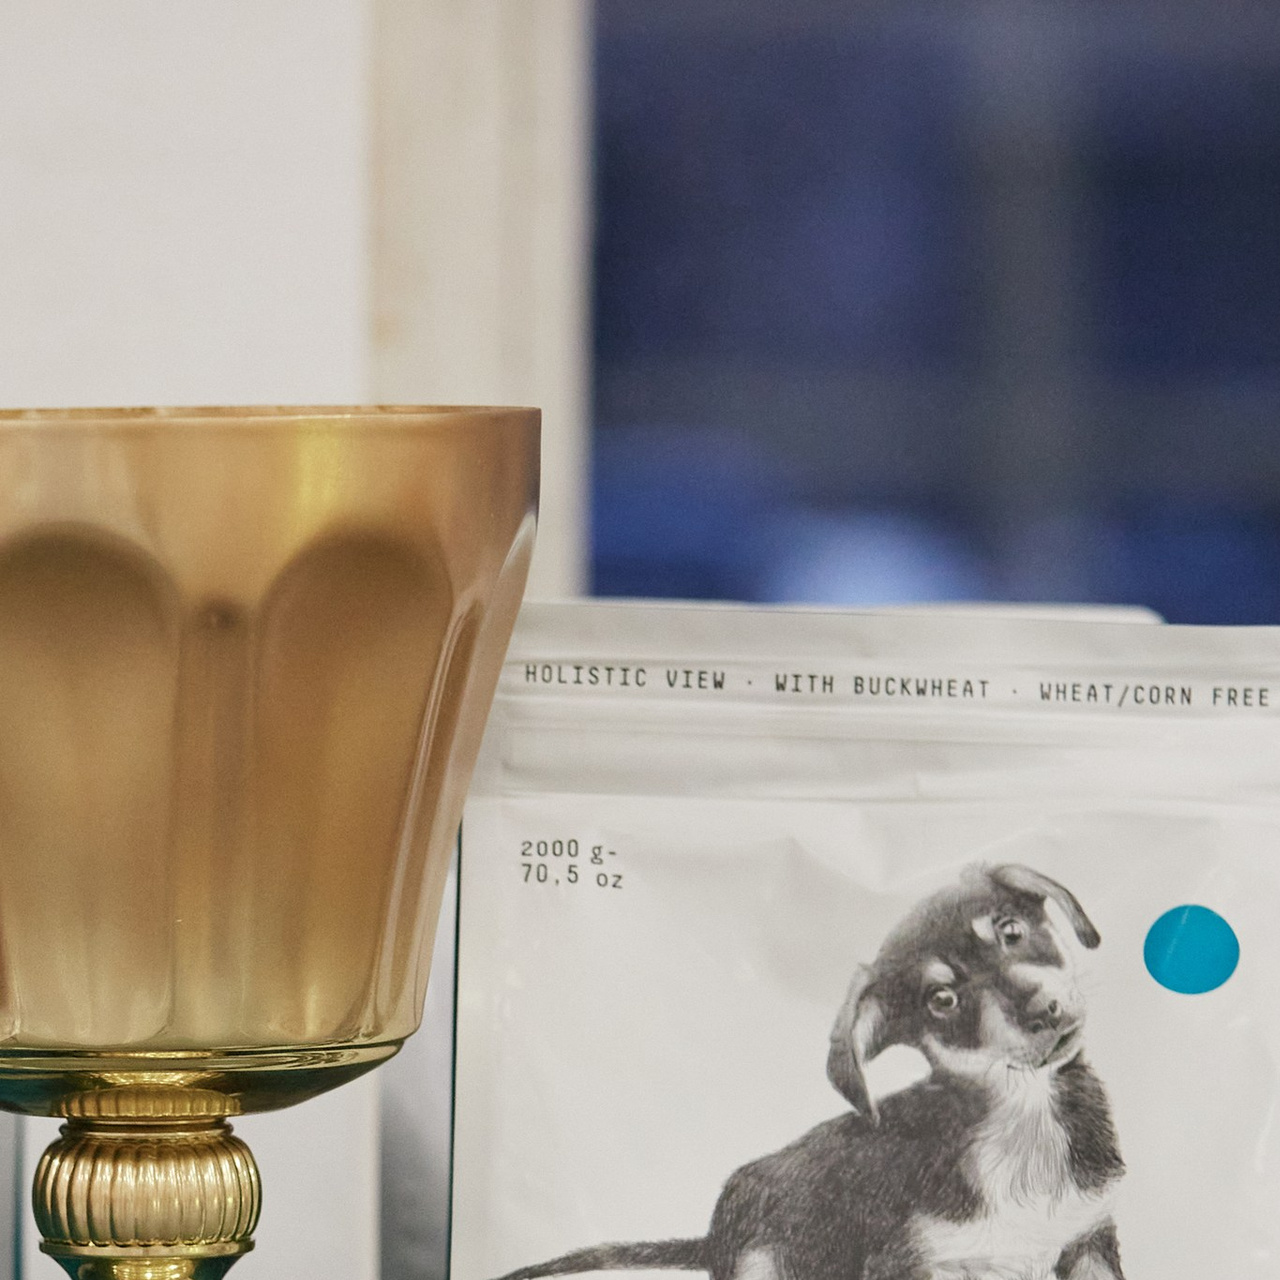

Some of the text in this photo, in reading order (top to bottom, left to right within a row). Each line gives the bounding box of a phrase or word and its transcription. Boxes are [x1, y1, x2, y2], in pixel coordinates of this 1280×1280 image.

[525, 664, 1271, 708] HOLISTIC VIEW WITH BUCKWHEAT WHEAT/CORN FREE
[520, 839, 617, 864] 2000 g-
[520, 863, 624, 888] 70,5 oz
